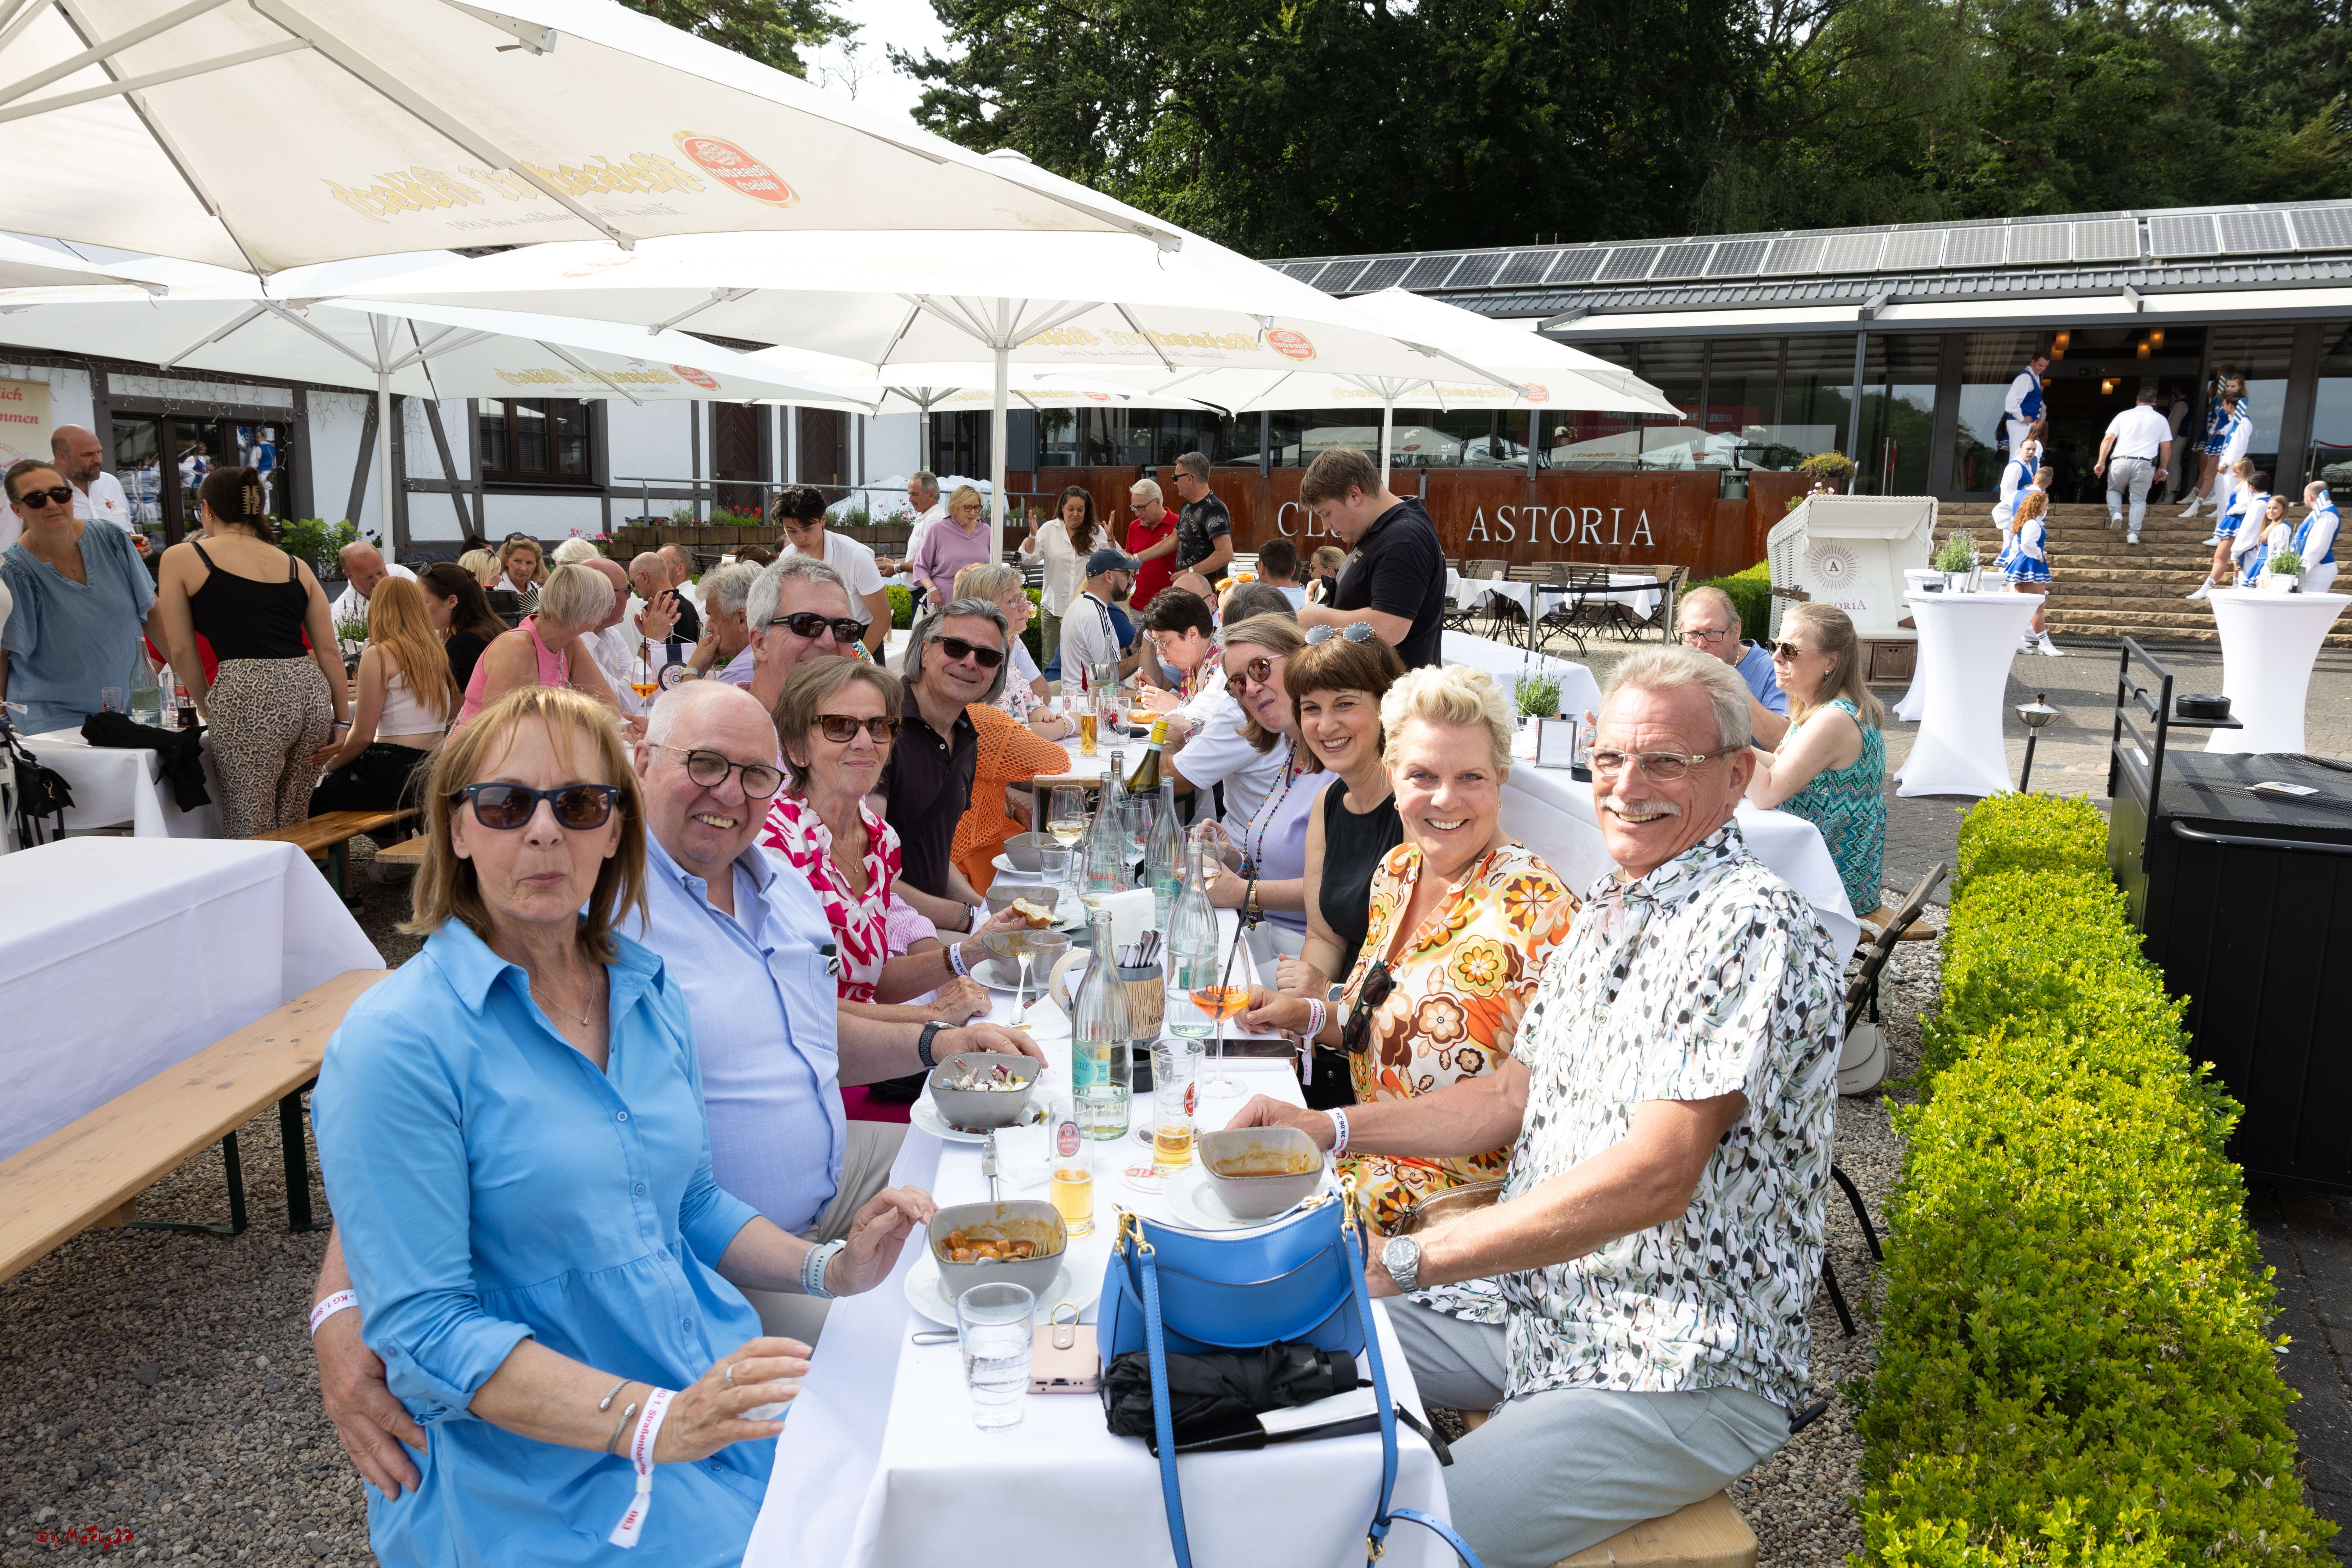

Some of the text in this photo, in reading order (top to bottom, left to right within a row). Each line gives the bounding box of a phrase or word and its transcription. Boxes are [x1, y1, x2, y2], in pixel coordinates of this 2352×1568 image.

[1466, 506, 1655, 546] ASTORIA
[1178, 554, 1196, 567] FAST
[1829, 561, 1840, 572] A
[955, 955, 965, 973] 29.06.24
[1205, 984, 1240, 995] LILLET
[1335, 1112, 1346, 1138] 29.06.24
[333, 1294, 348, 1305] KG
